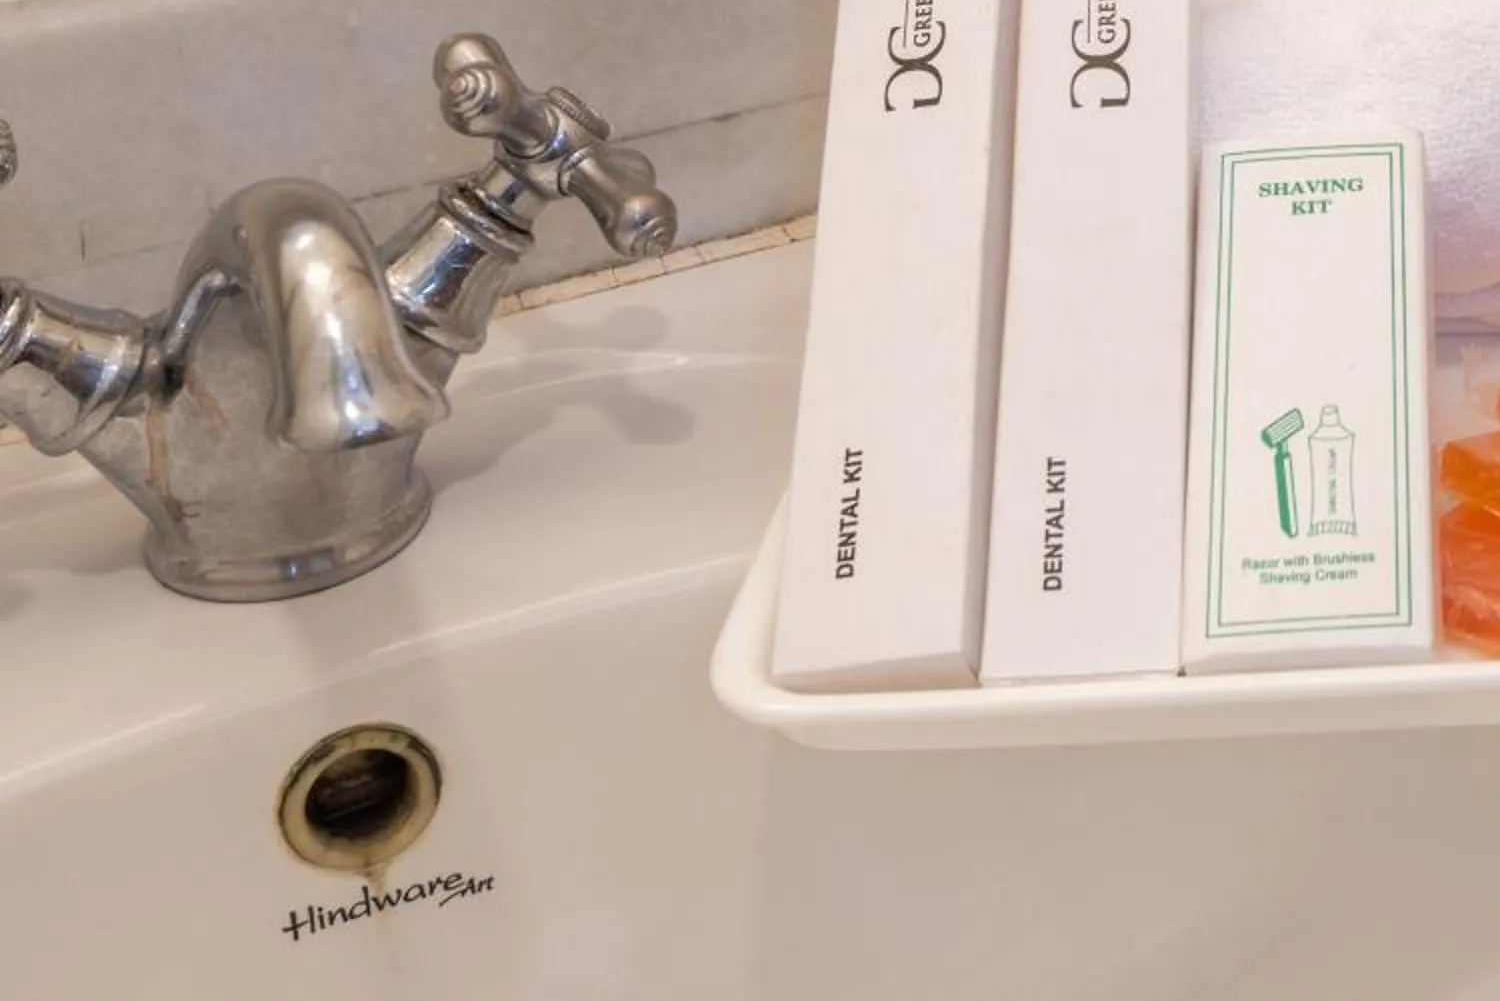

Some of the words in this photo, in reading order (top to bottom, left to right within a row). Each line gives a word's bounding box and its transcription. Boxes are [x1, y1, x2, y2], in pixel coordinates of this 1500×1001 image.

[1258, 177, 1364, 198] SHAVING
[1291, 199, 1333, 216] KIT
[842, 447, 863, 484] KIT
[1046, 456, 1067, 494] KIT
[835, 487, 861, 580] DENTAL
[1042, 499, 1066, 592] DENTAL
[1241, 557, 1280, 571] Razor
[1283, 555, 1309, 567] with
[1313, 551, 1376, 566] Brushless
[1259, 570, 1311, 585] Shaving
[1315, 568, 1359, 582] Cream
[282, 872, 463, 942] Hindware
[458, 875, 495, 897] Art
